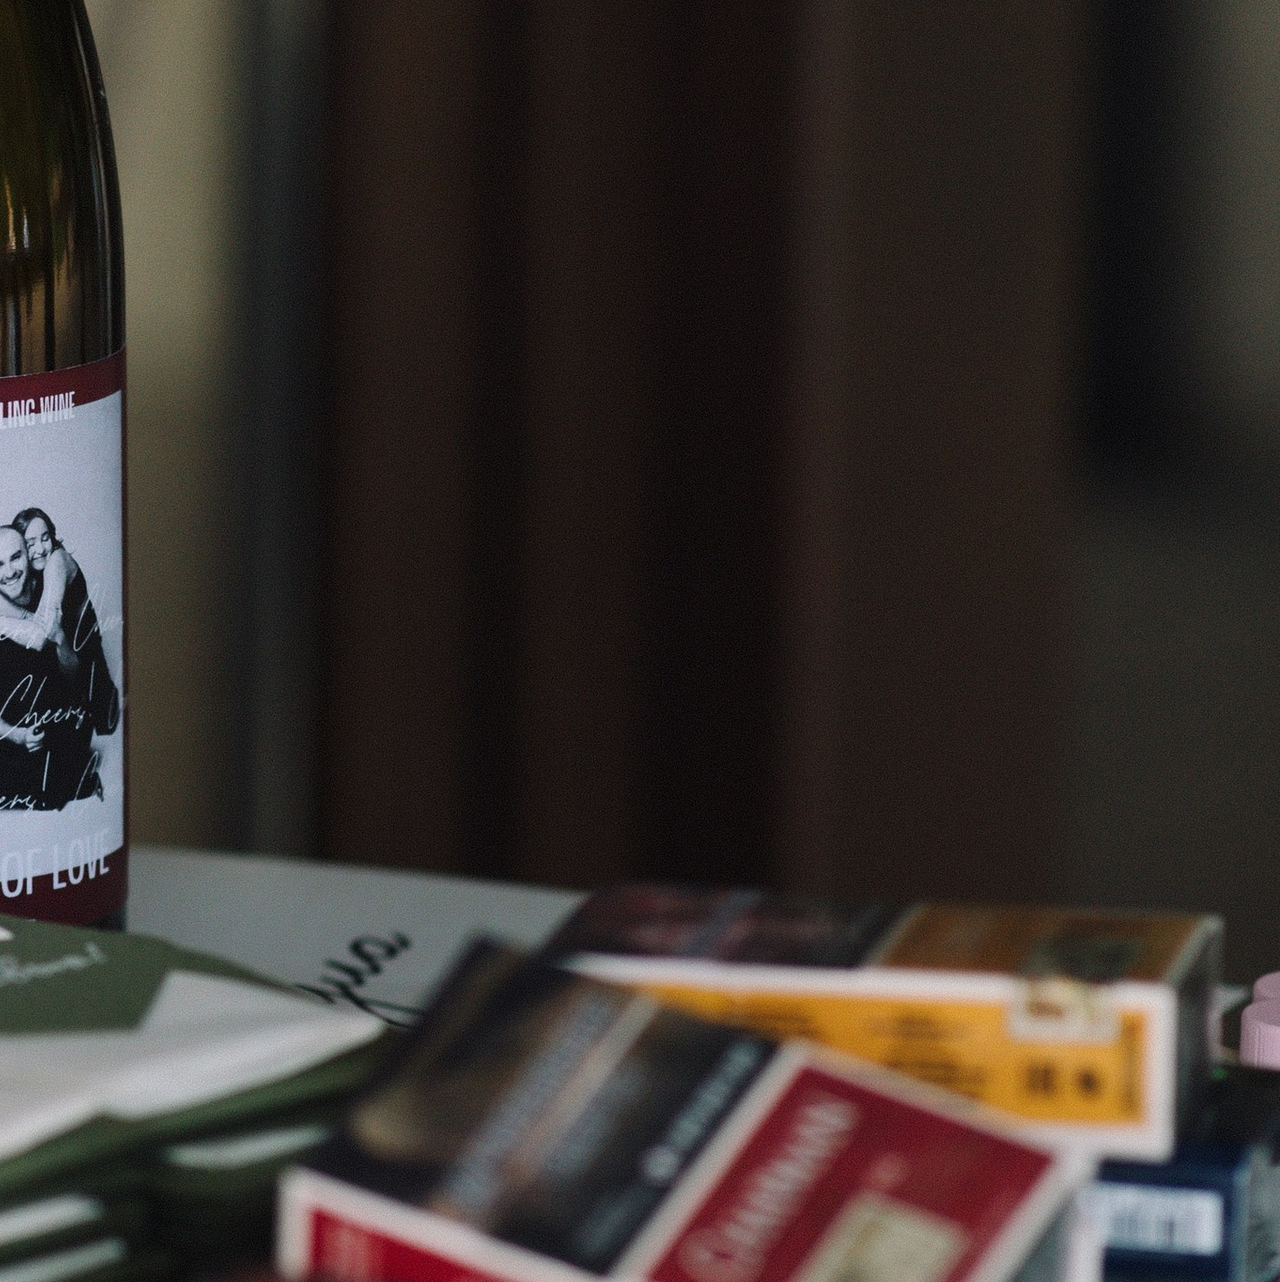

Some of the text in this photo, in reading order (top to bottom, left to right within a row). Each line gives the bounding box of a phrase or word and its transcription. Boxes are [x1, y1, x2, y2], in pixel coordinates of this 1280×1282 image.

[39, 390, 76, 423] WINE
[0, 848, 43, 899] OF
[52, 825, 110, 891] LOVE
